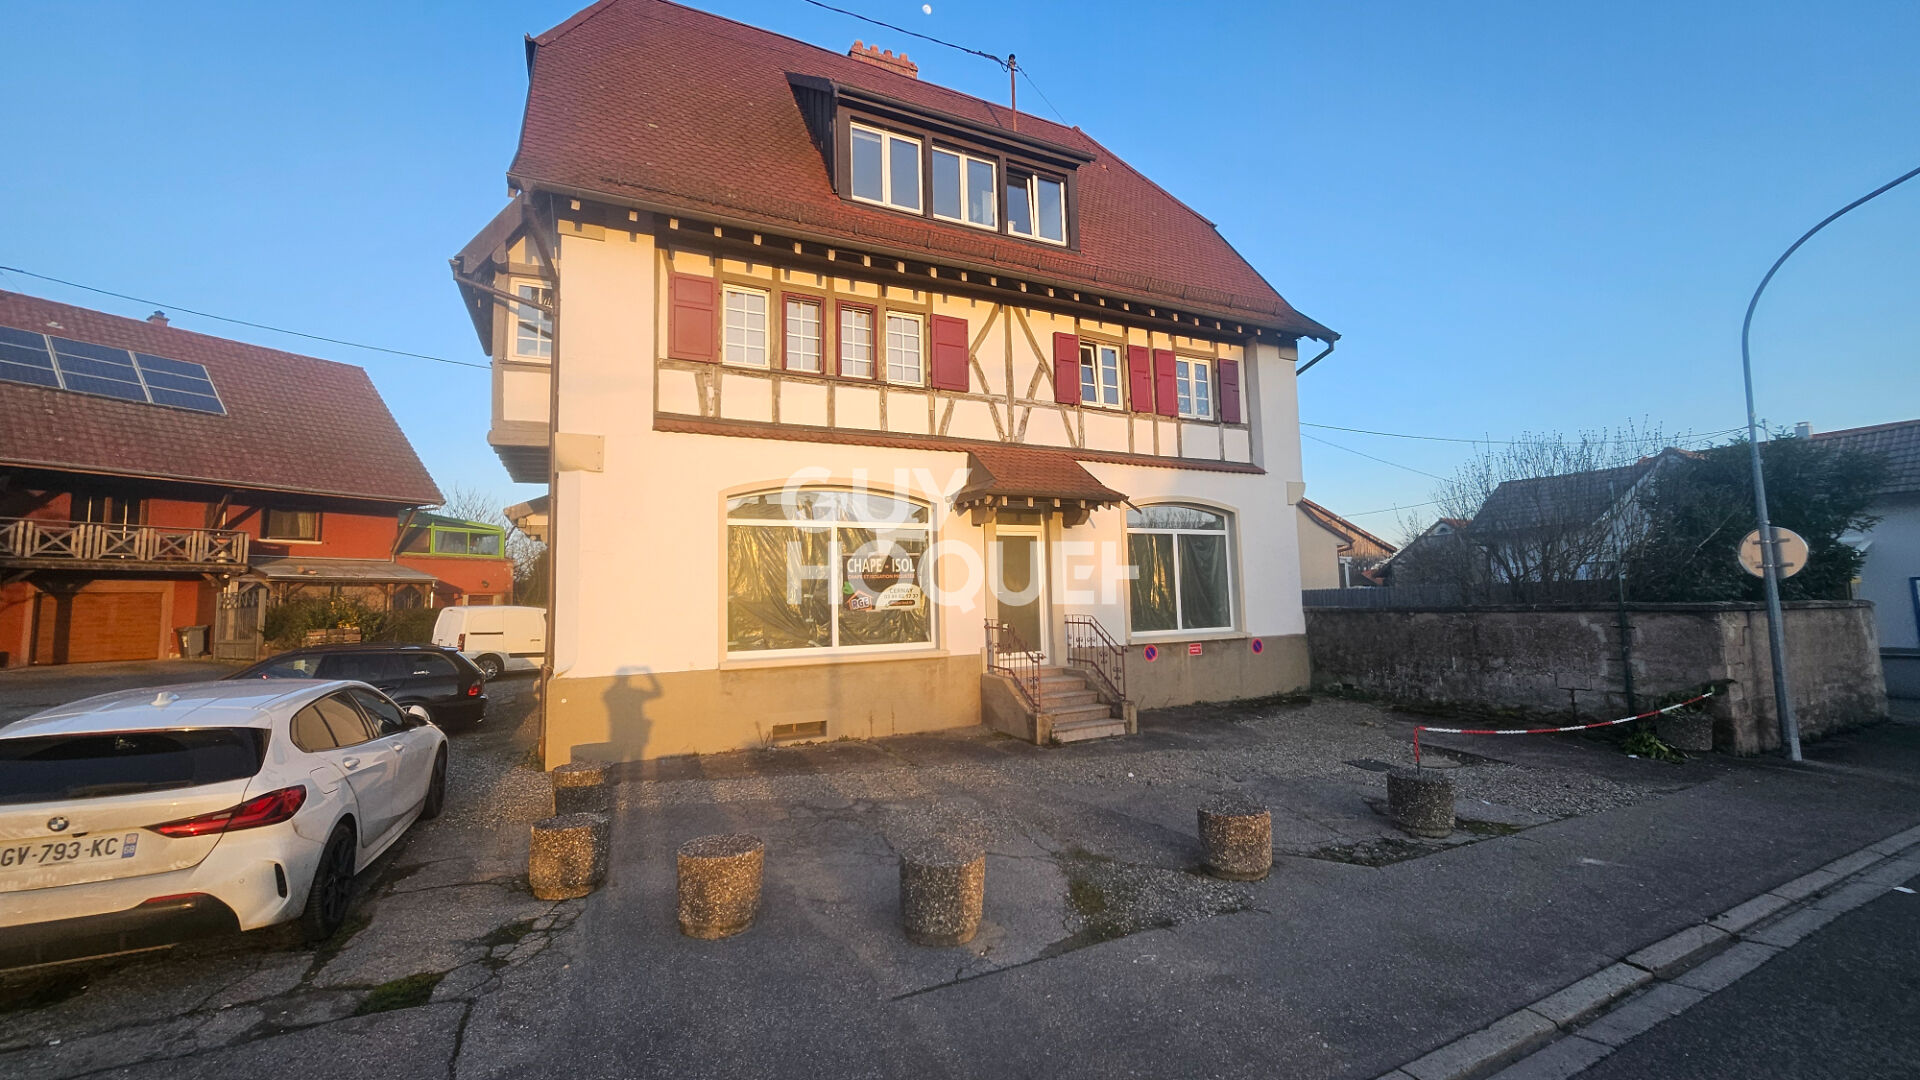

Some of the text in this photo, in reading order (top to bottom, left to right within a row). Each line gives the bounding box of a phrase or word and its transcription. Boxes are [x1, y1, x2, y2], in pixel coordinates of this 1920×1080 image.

[847, 558, 882, 572] CHAPE
[892, 558, 915, 572] ISOL
[851, 597, 869, 609] RGE
[0, 837, 119, 867] GV-793-KC
